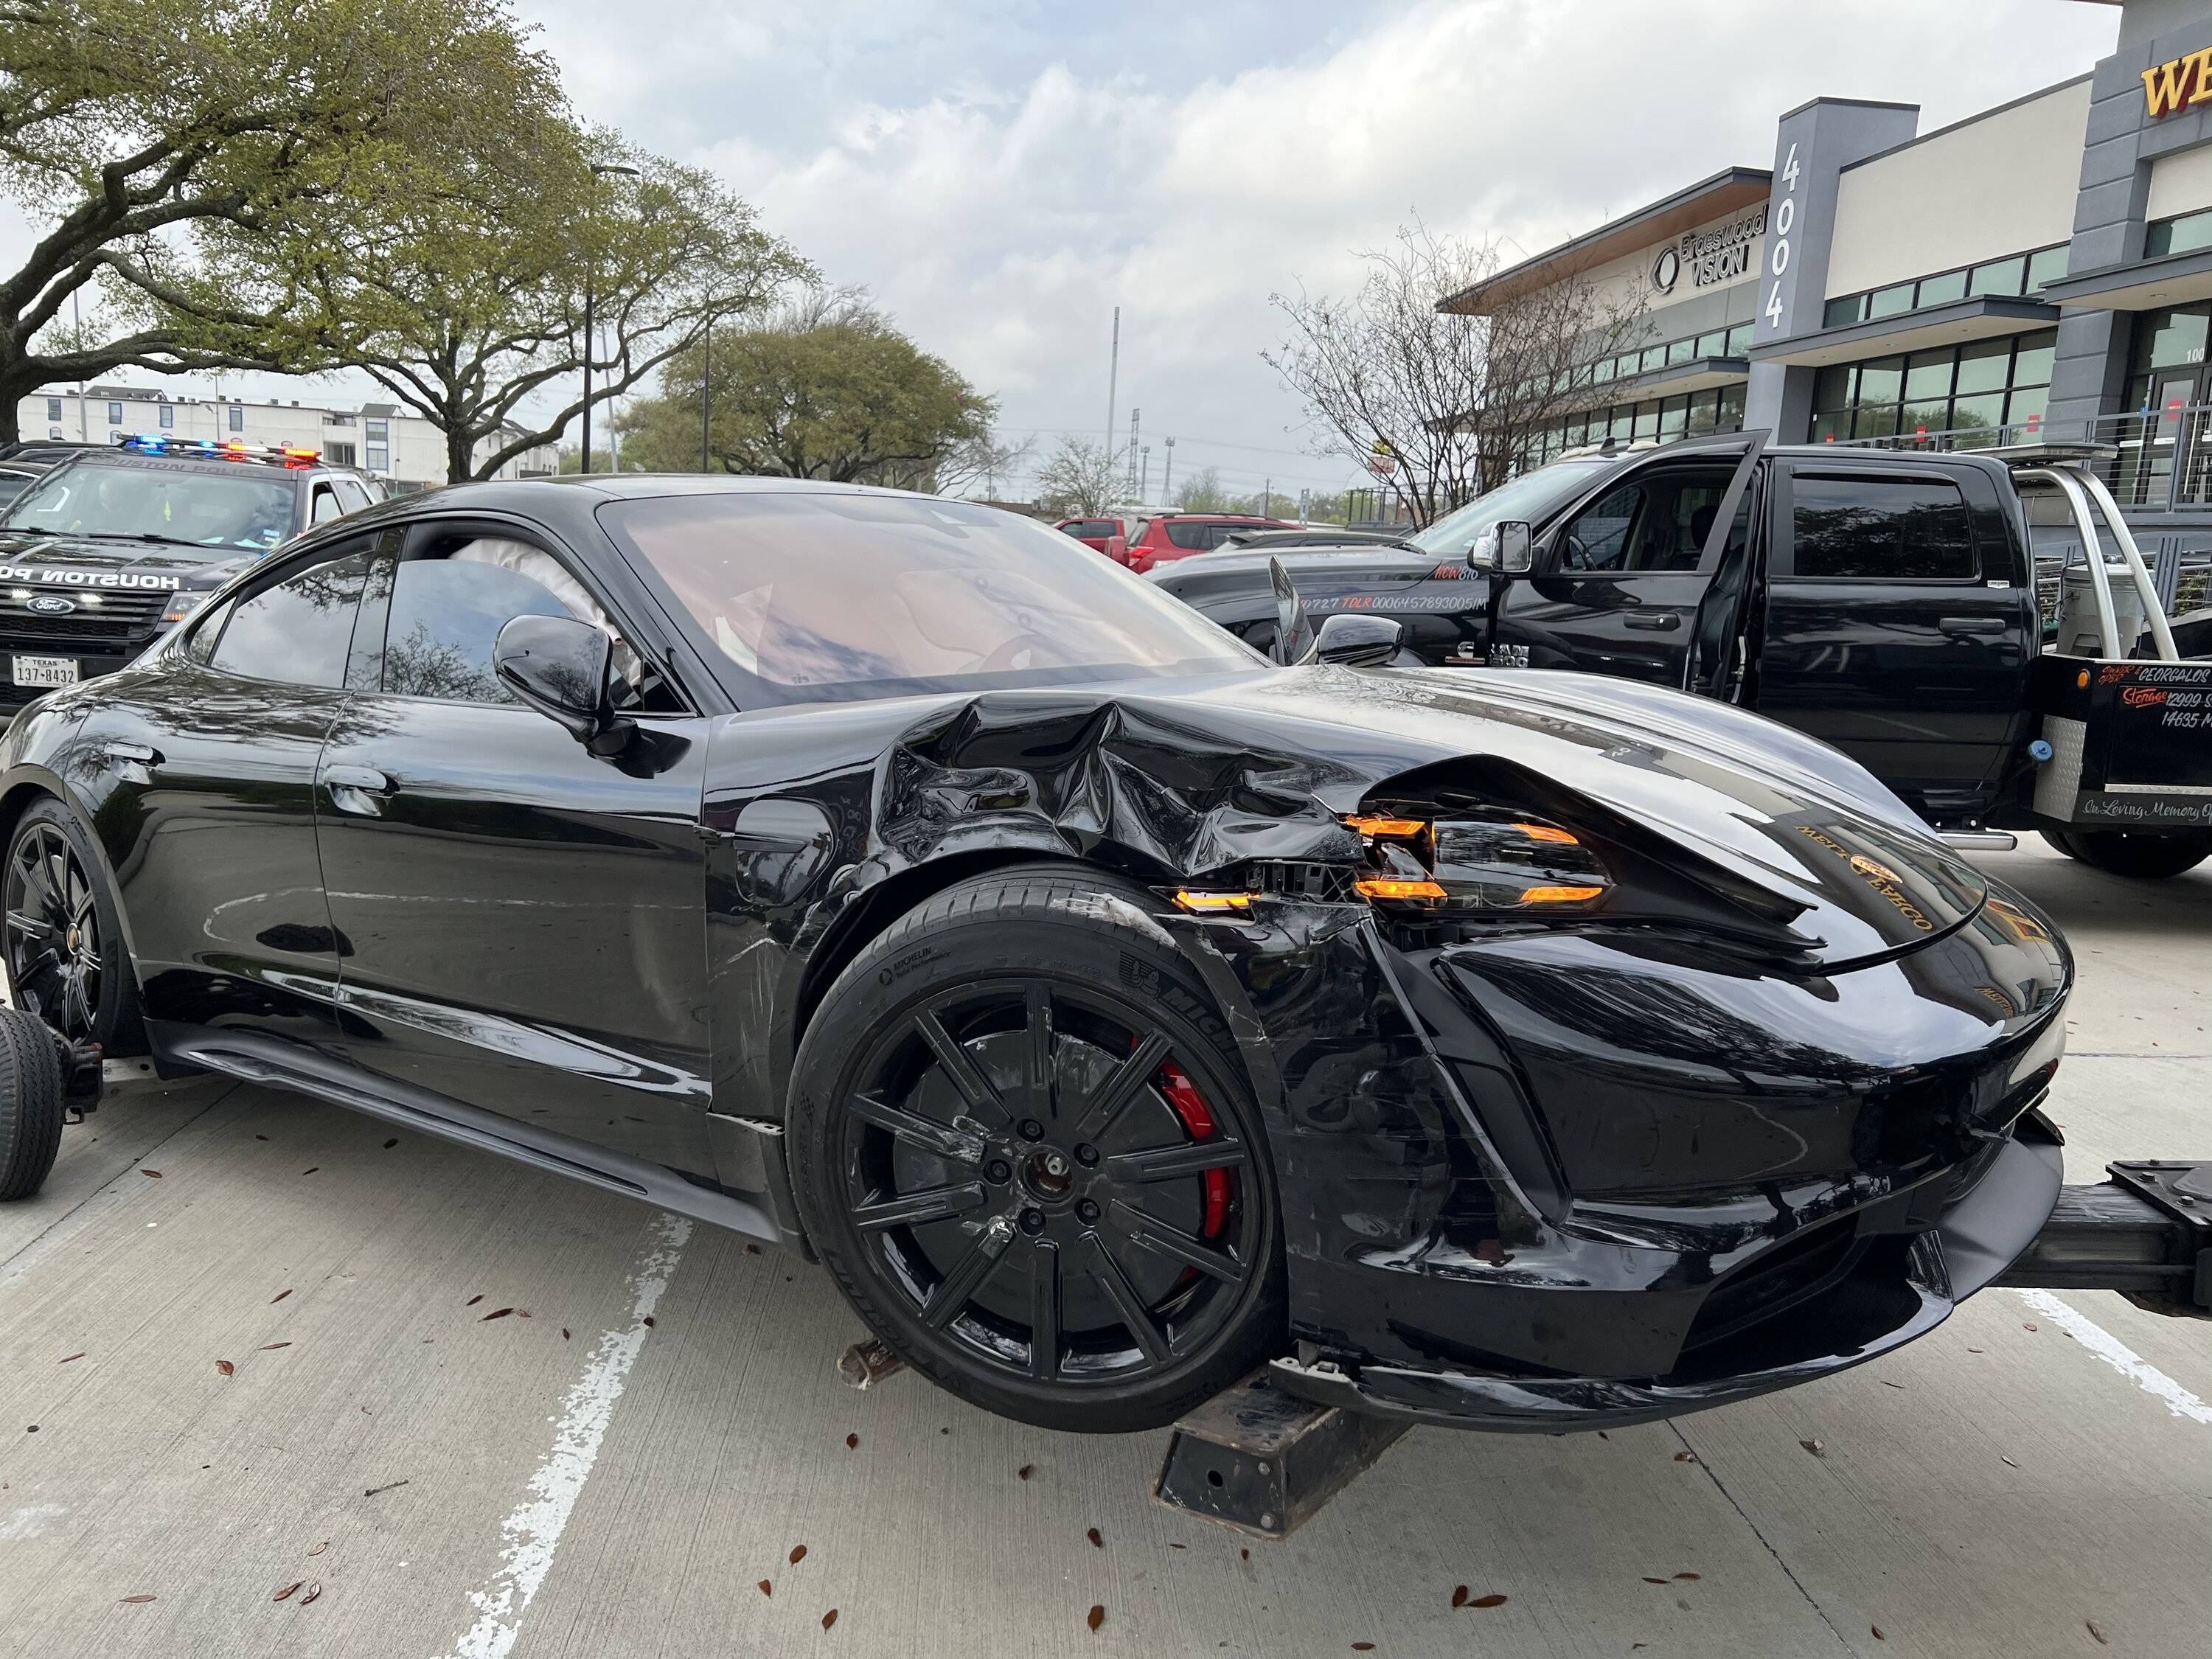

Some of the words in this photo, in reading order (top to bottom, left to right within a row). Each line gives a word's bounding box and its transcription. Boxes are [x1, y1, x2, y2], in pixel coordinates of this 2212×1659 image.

[1680, 205, 1768, 262] Braeswood
[1765, 143, 1800, 328] 4004
[1691, 244, 1748, 286] VISION
[2186, 349, 2204, 362] 100
[2139, 667, 2211, 683] GEORGALOS
[2166, 692, 2202, 707] 12999
[2101, 799, 2143, 820] Loving
[2144, 801, 2199, 821] Memory
[894, 947, 932, 970] MICHELIN
